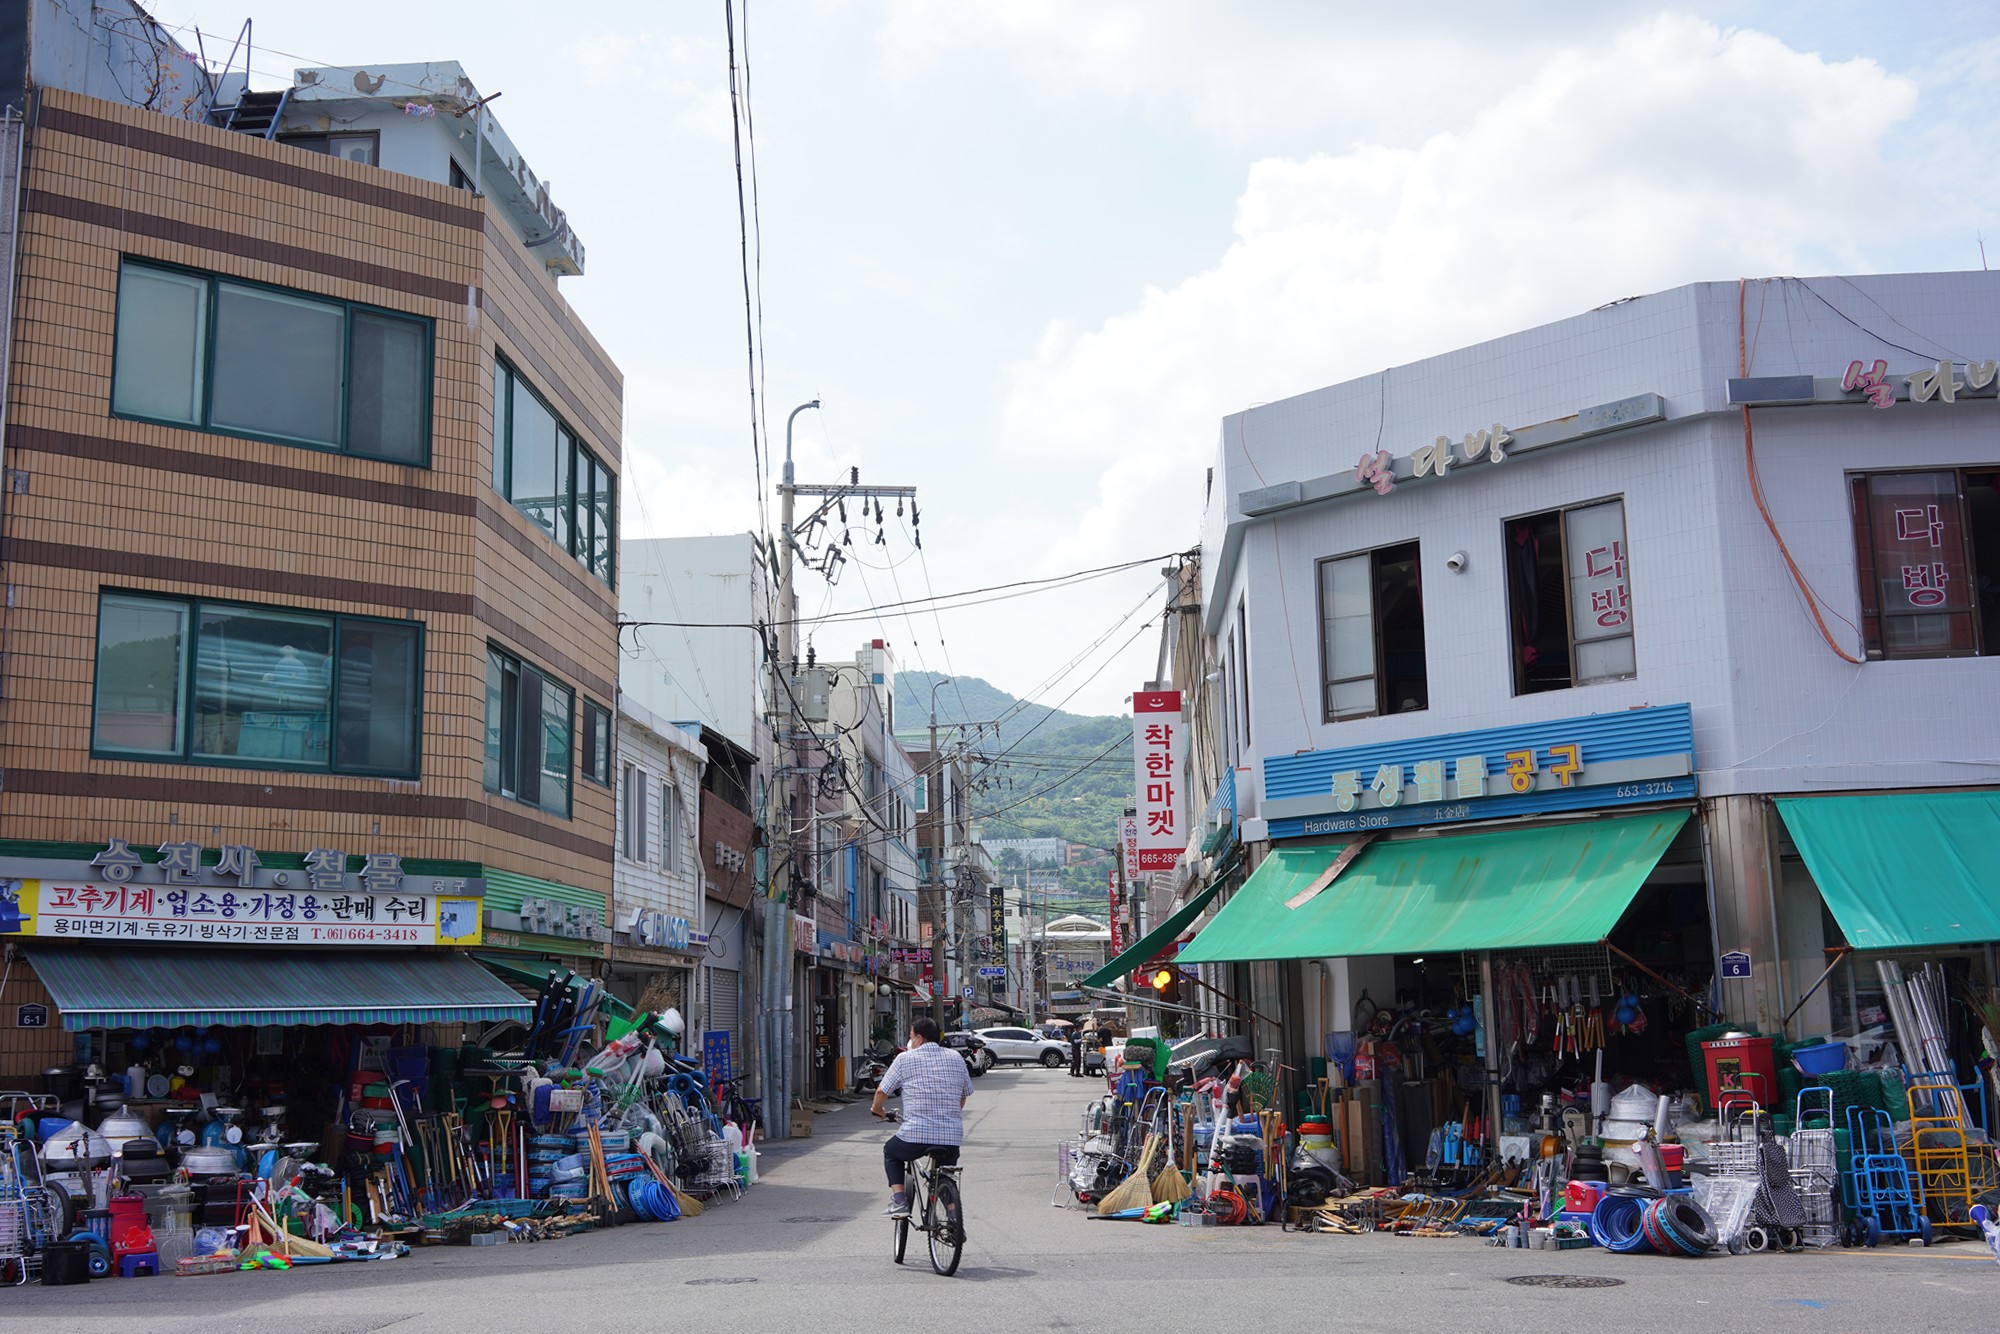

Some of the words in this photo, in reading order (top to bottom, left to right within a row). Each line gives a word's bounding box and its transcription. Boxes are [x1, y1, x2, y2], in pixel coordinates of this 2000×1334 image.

[1505, 744, 1584, 793] 공구
[1144, 724, 1175, 836] 착한마켓
[1617, 785, 1638, 798] 663
[1646, 782, 1674, 795] 3716
[1304, 820, 1356, 833] Hardware
[1359, 815, 1389, 828] Store
[1142, 853, 1178, 864] 665-289
[432, 879, 465, 892] 공구
[384, 897, 427, 922] 수리
[645, 911, 689, 950] JEVISCO
[1056, 961, 1095, 972] 교동시장
[1732, 964, 1740, 975] 6
[964, 989, 972, 998] P
[23, 1015, 40, 1025] 6-1
